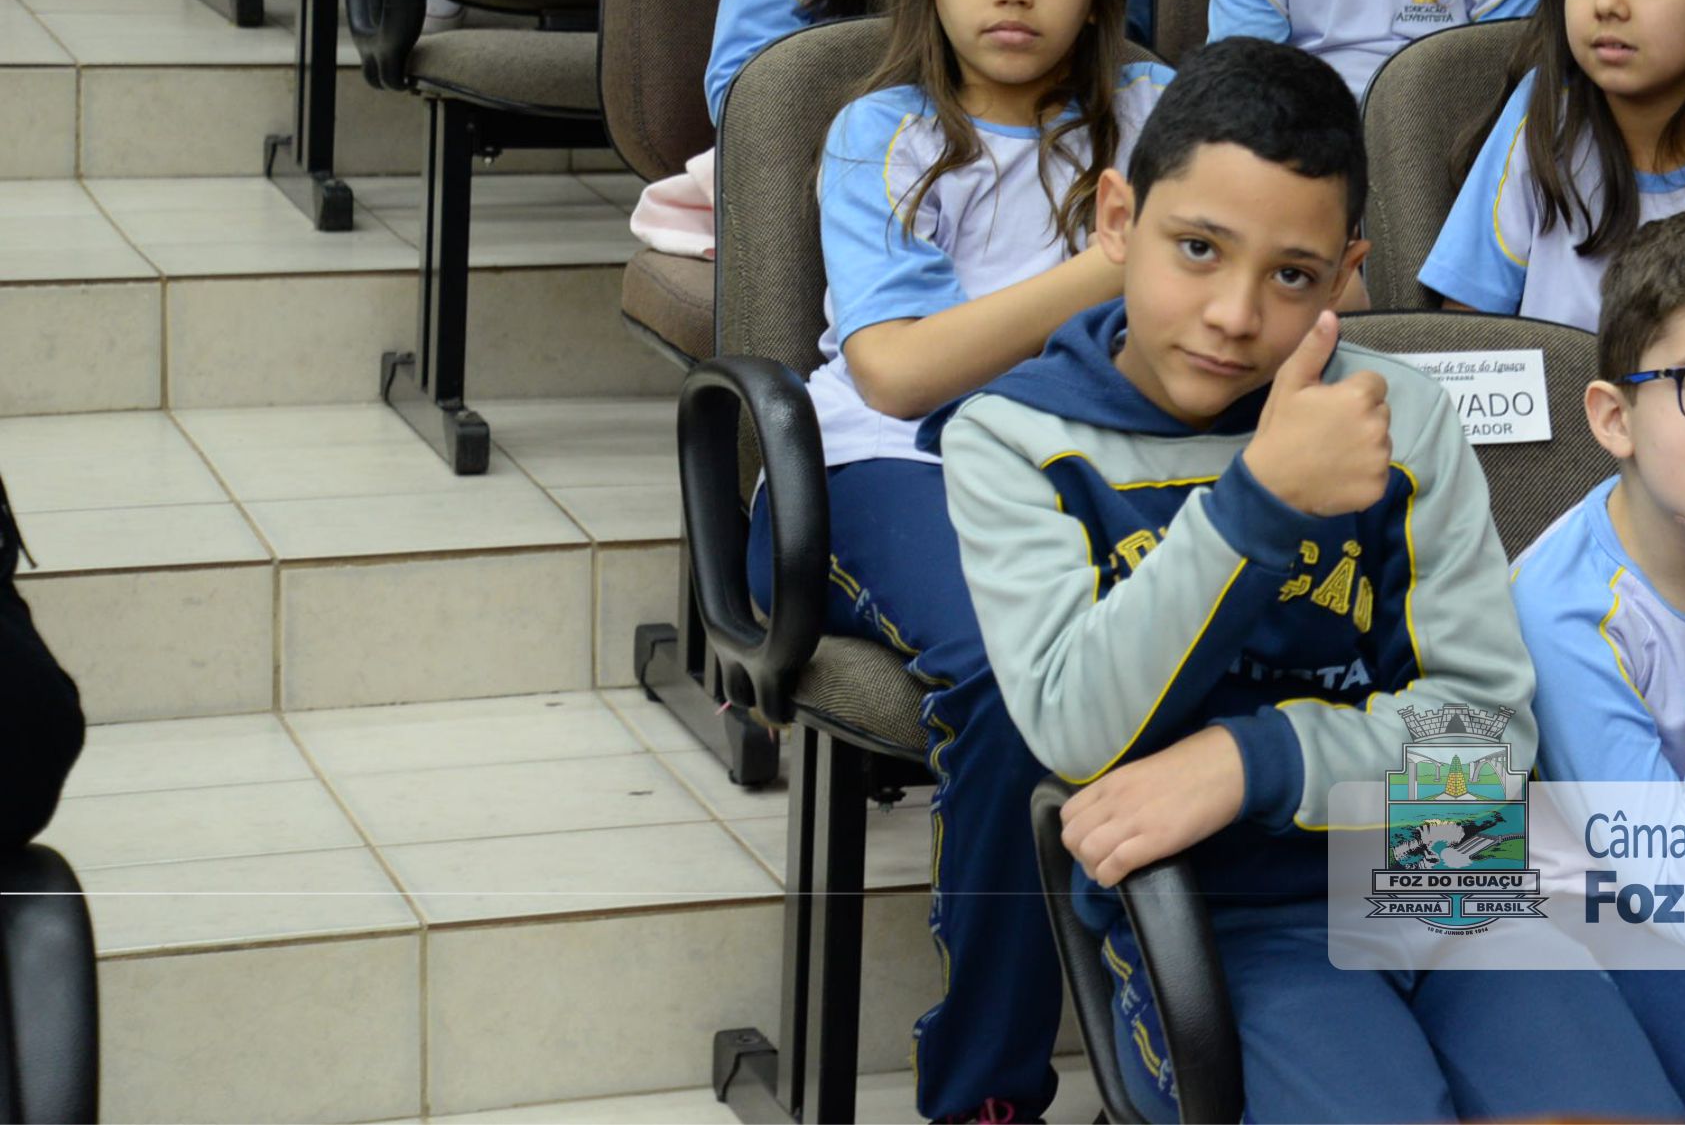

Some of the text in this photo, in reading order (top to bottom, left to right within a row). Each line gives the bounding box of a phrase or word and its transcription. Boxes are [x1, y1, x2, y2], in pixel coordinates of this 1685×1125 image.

[1444, 361, 1455, 372] de
[1457, 361, 1476, 373] Foz
[1478, 360, 1491, 372] do
[1493, 360, 1526, 374] Iguaçu
